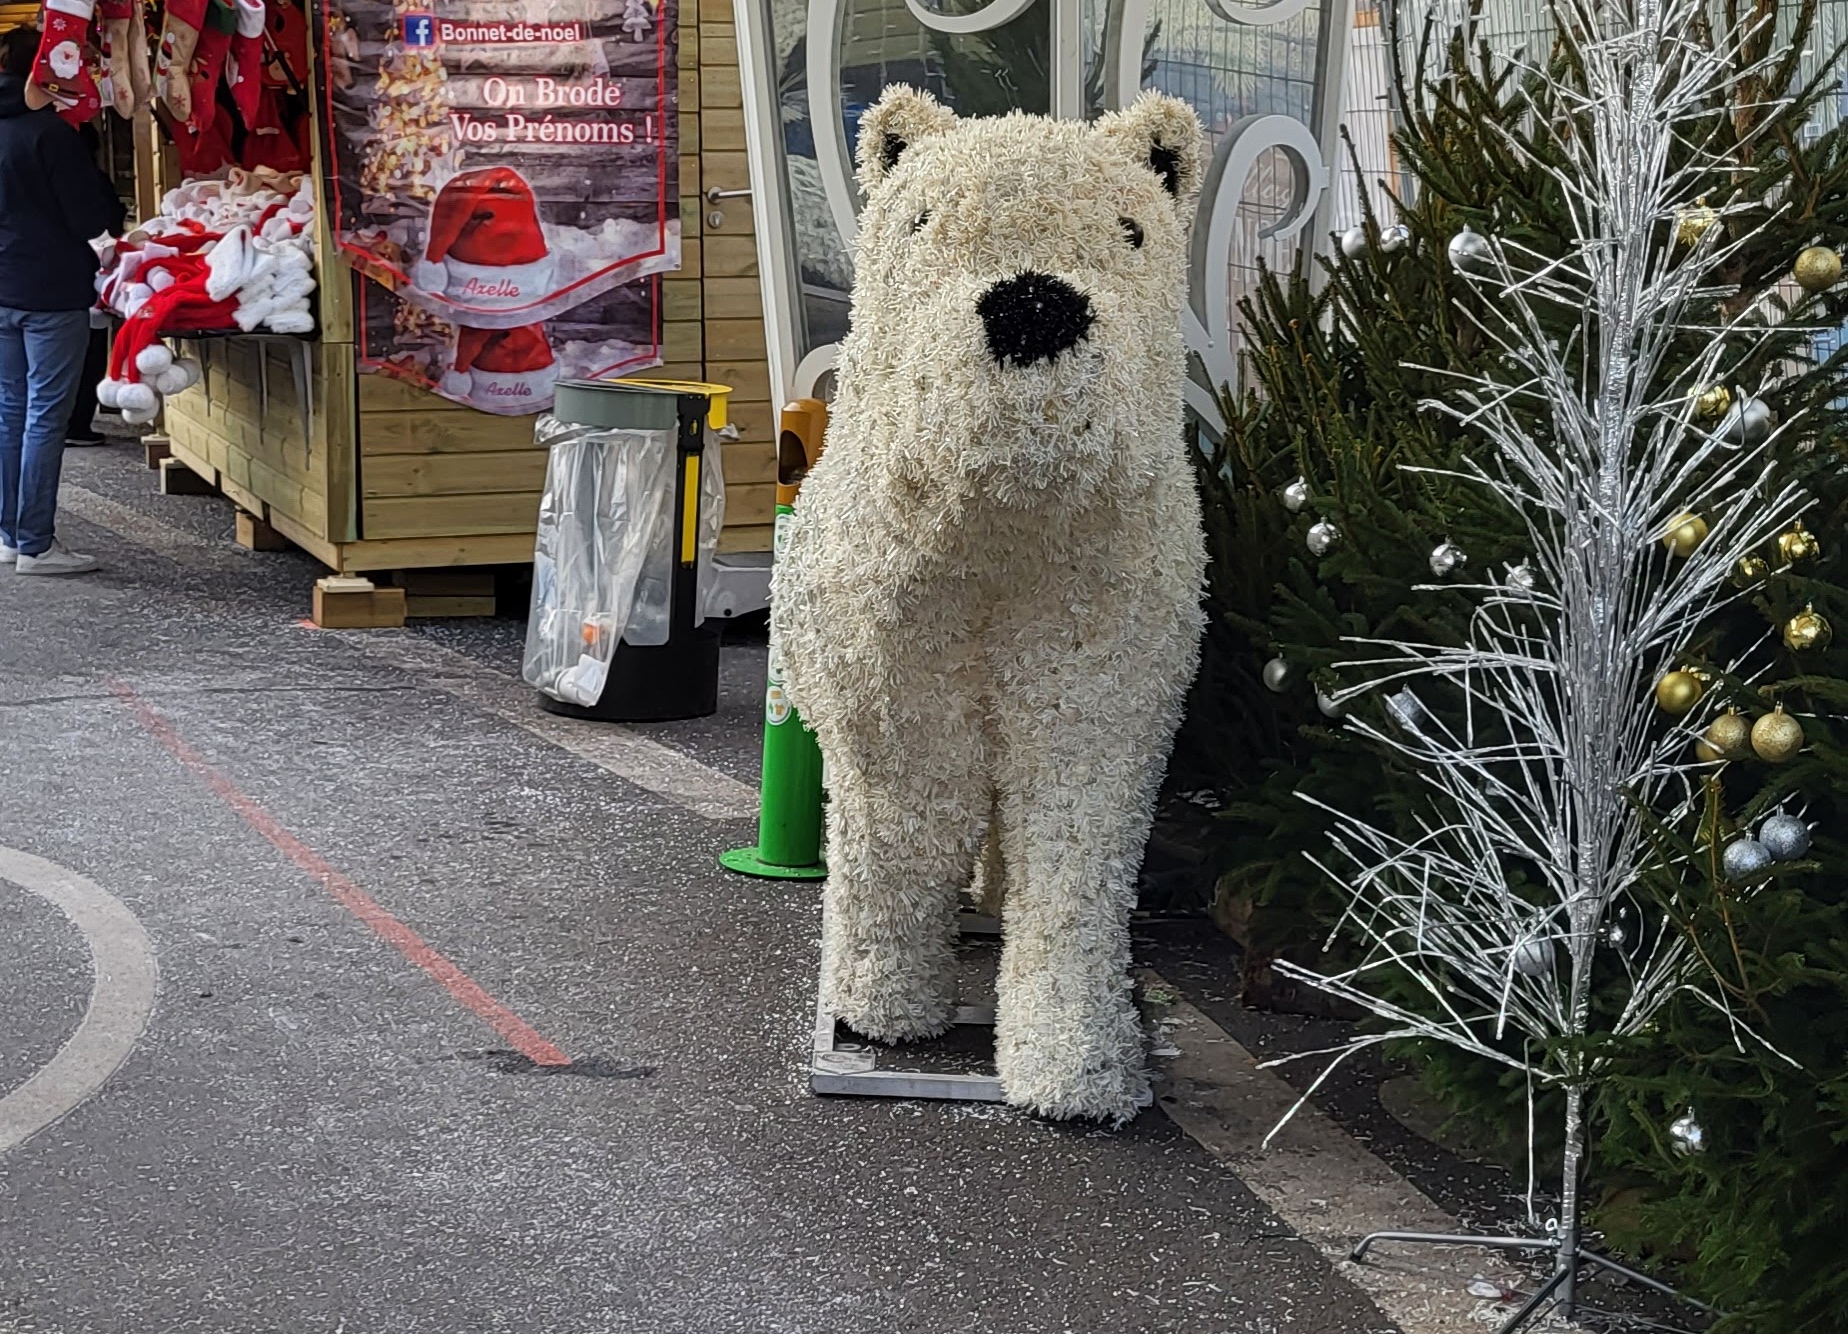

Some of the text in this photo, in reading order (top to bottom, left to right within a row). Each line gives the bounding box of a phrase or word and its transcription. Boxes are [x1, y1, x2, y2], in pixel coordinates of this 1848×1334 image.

[440, 23, 580, 41] Bonnet-de-noel
[483, 77, 621, 107] On Brode
[449, 113, 498, 142] Vos
[505, 113, 634, 144] Prénoms
[462, 276, 521, 298] Axelle
